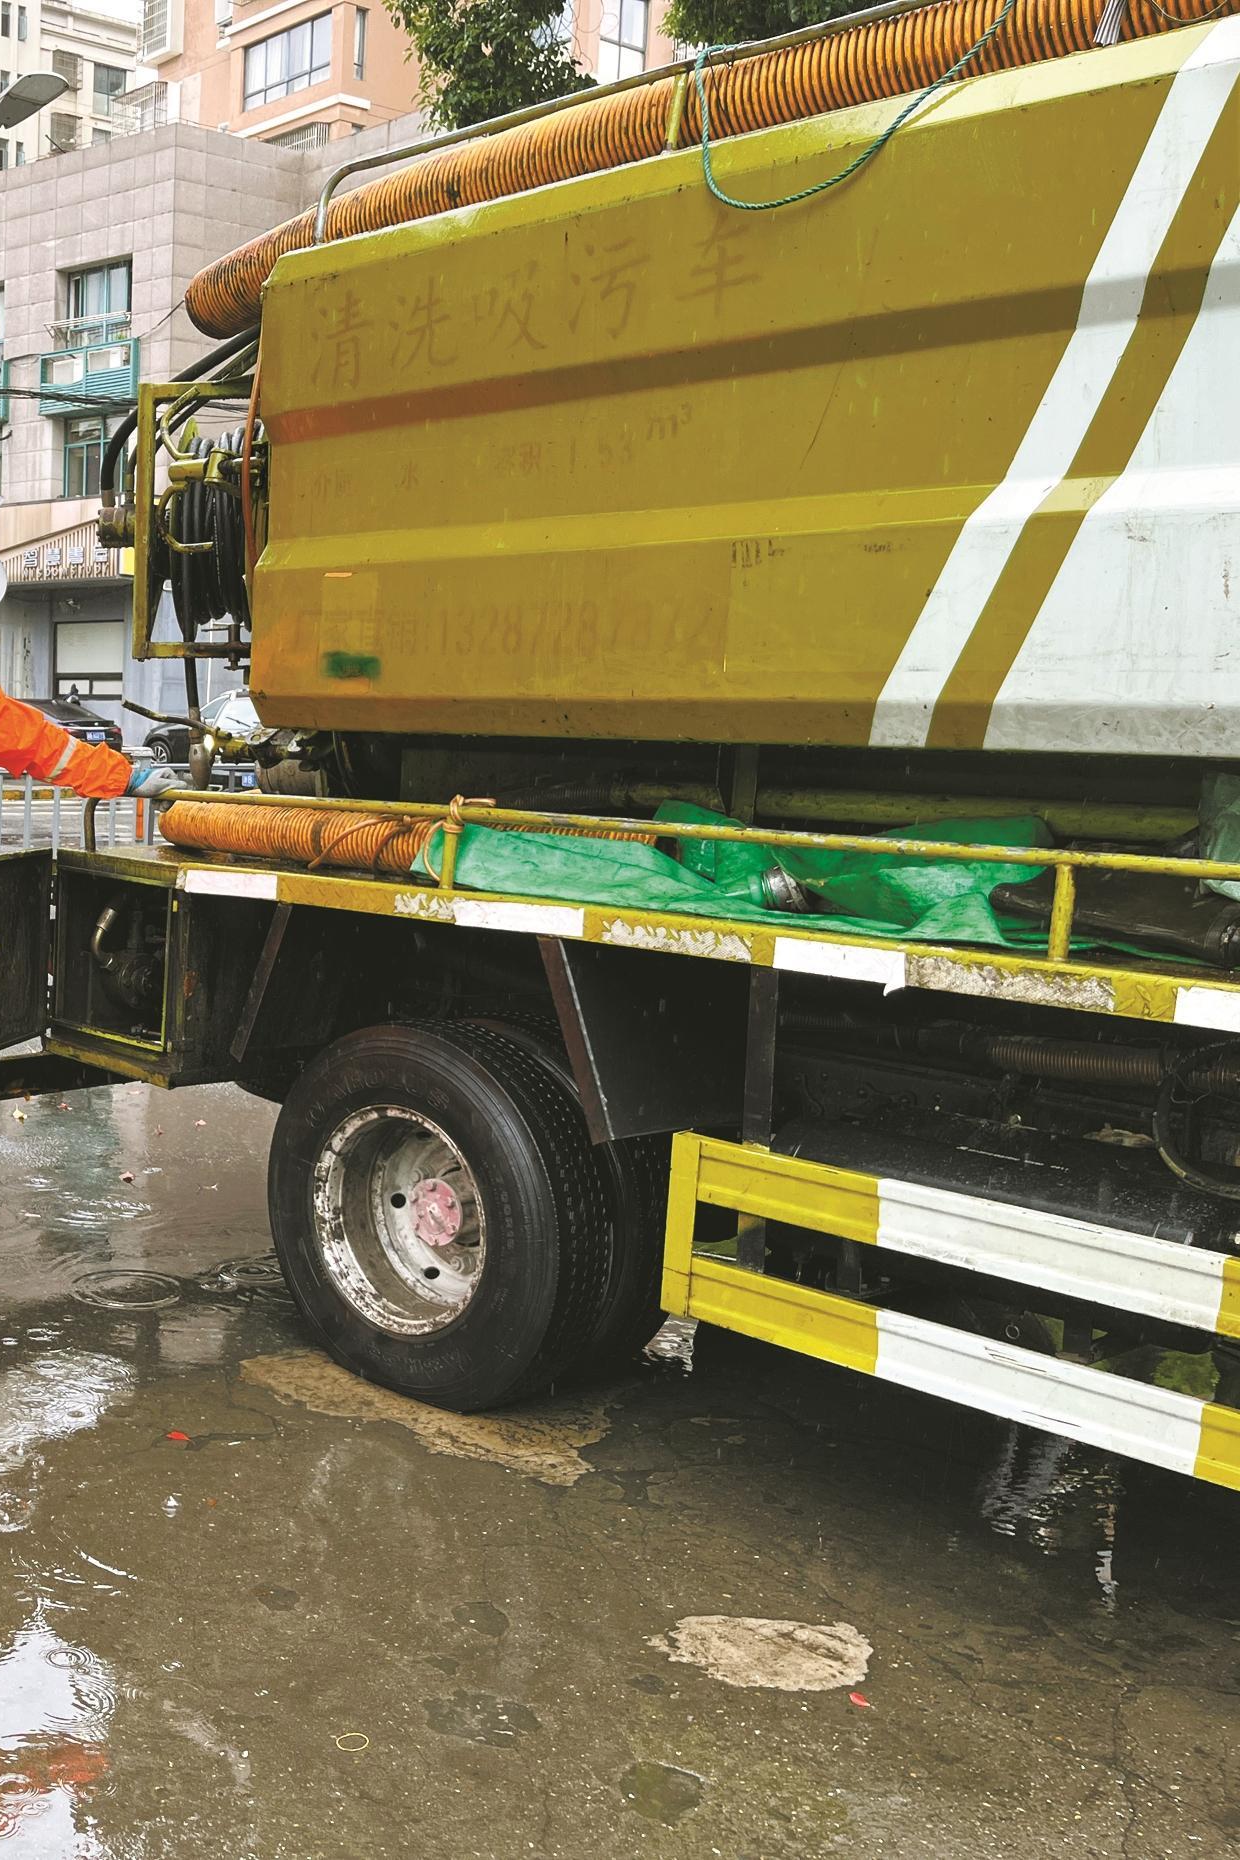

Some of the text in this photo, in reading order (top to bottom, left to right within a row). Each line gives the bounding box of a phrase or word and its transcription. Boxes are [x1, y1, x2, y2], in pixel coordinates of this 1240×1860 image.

[310, 214, 762, 391] 清洗吸污车
